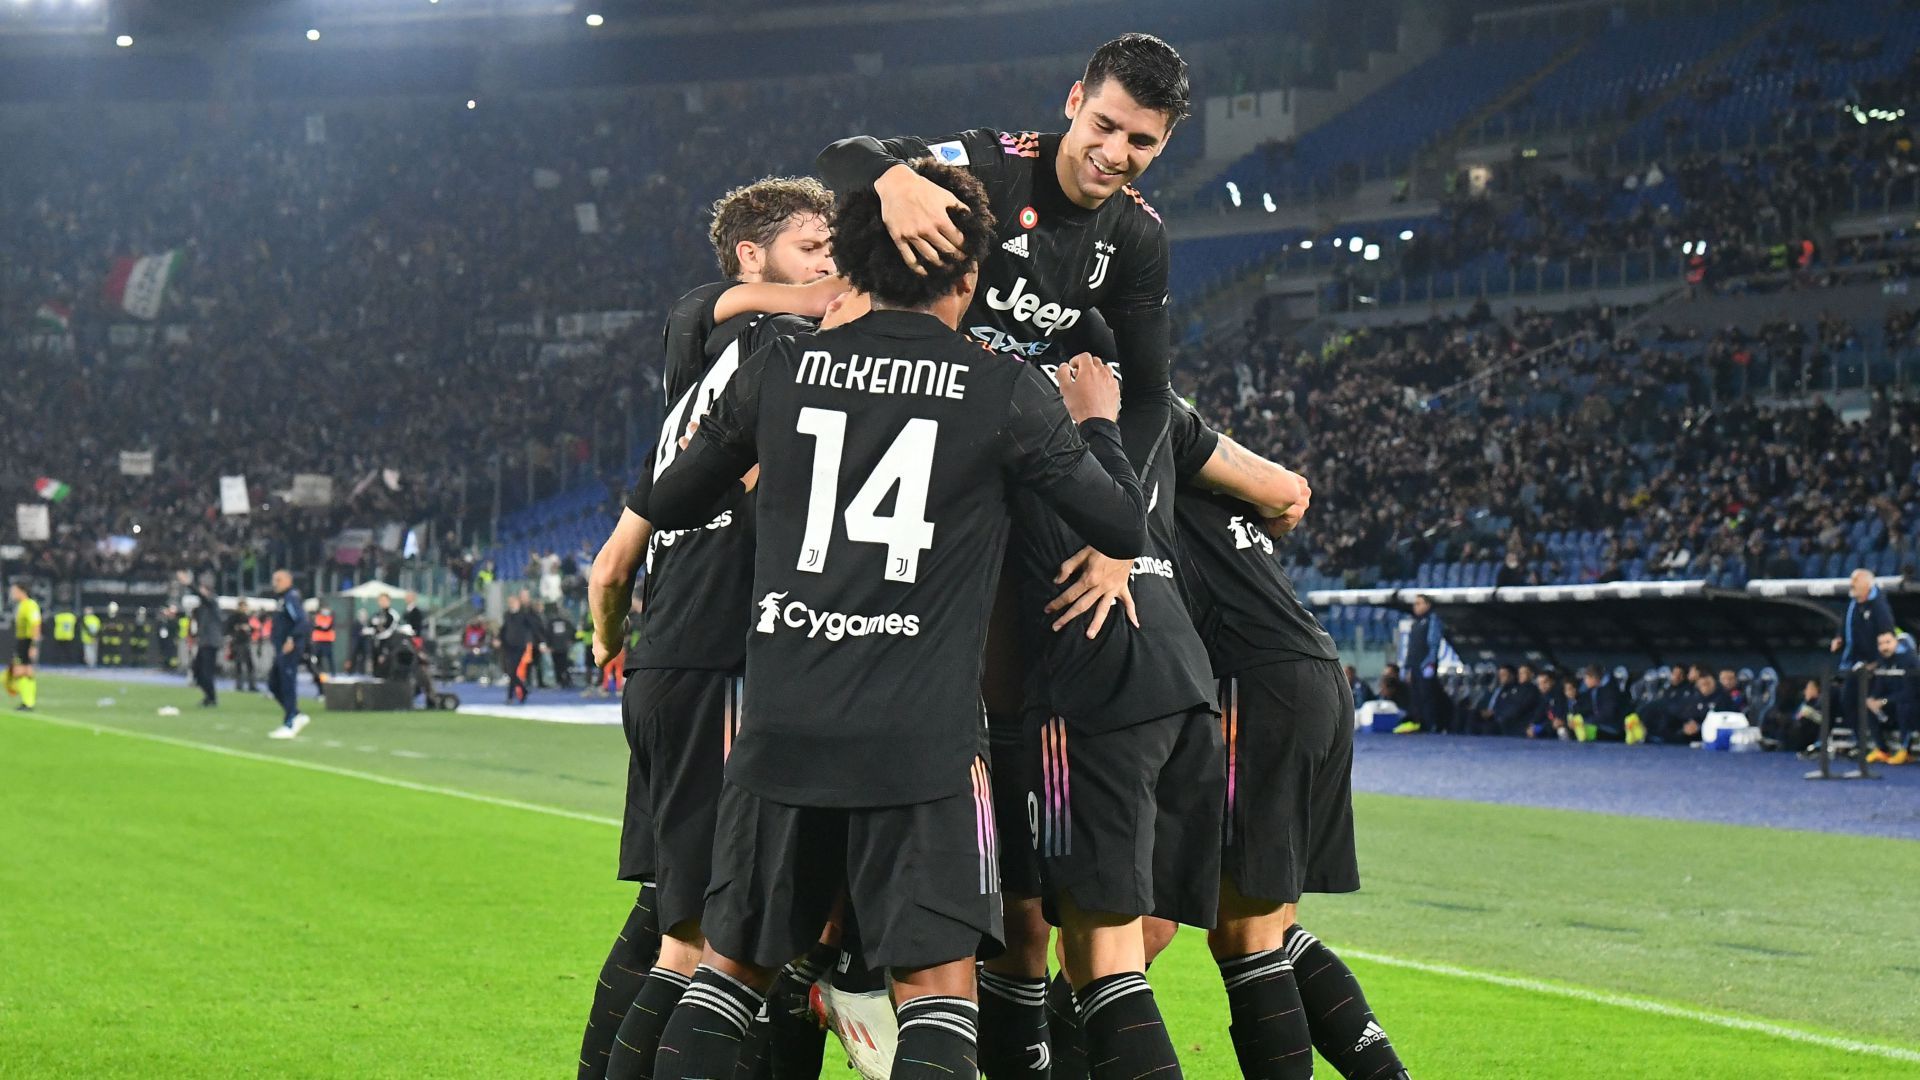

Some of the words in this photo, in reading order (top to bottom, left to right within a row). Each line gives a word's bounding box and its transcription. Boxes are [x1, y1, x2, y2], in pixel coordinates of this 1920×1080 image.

[986, 276, 1082, 337] Jeep
[796, 406, 939, 584] 14
[783, 601, 920, 642] Cygames
[1027, 791, 1039, 850] 9
